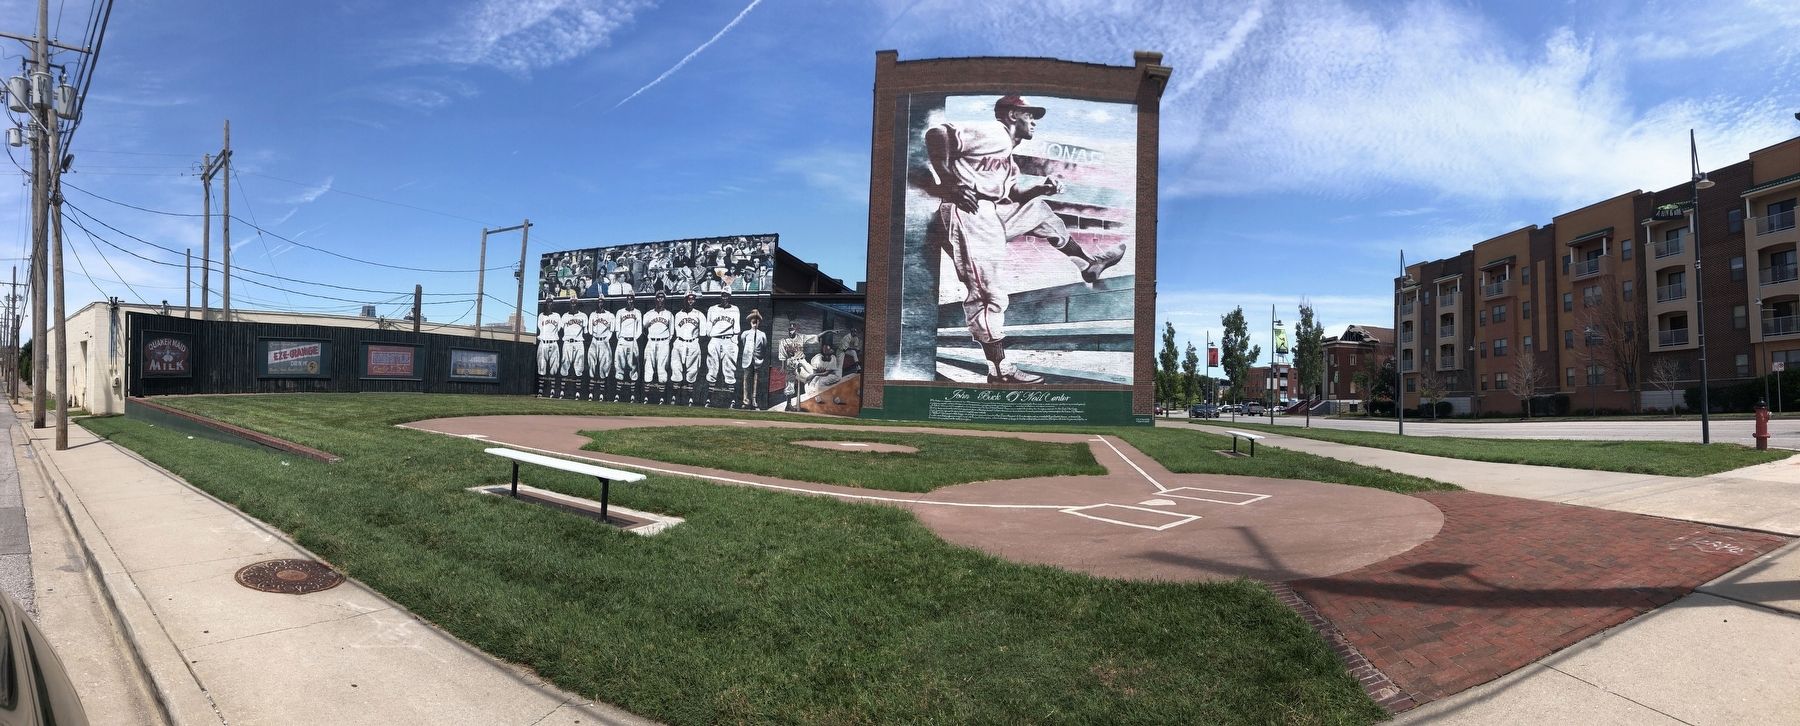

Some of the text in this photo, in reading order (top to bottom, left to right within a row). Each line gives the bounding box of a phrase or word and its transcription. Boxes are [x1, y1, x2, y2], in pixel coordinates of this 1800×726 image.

[149, 338, 186, 352] QUAKER MAID
[149, 359, 185, 371] MILK
[945, 389, 970, 401] John
[1043, 391, 1071, 402] Center
